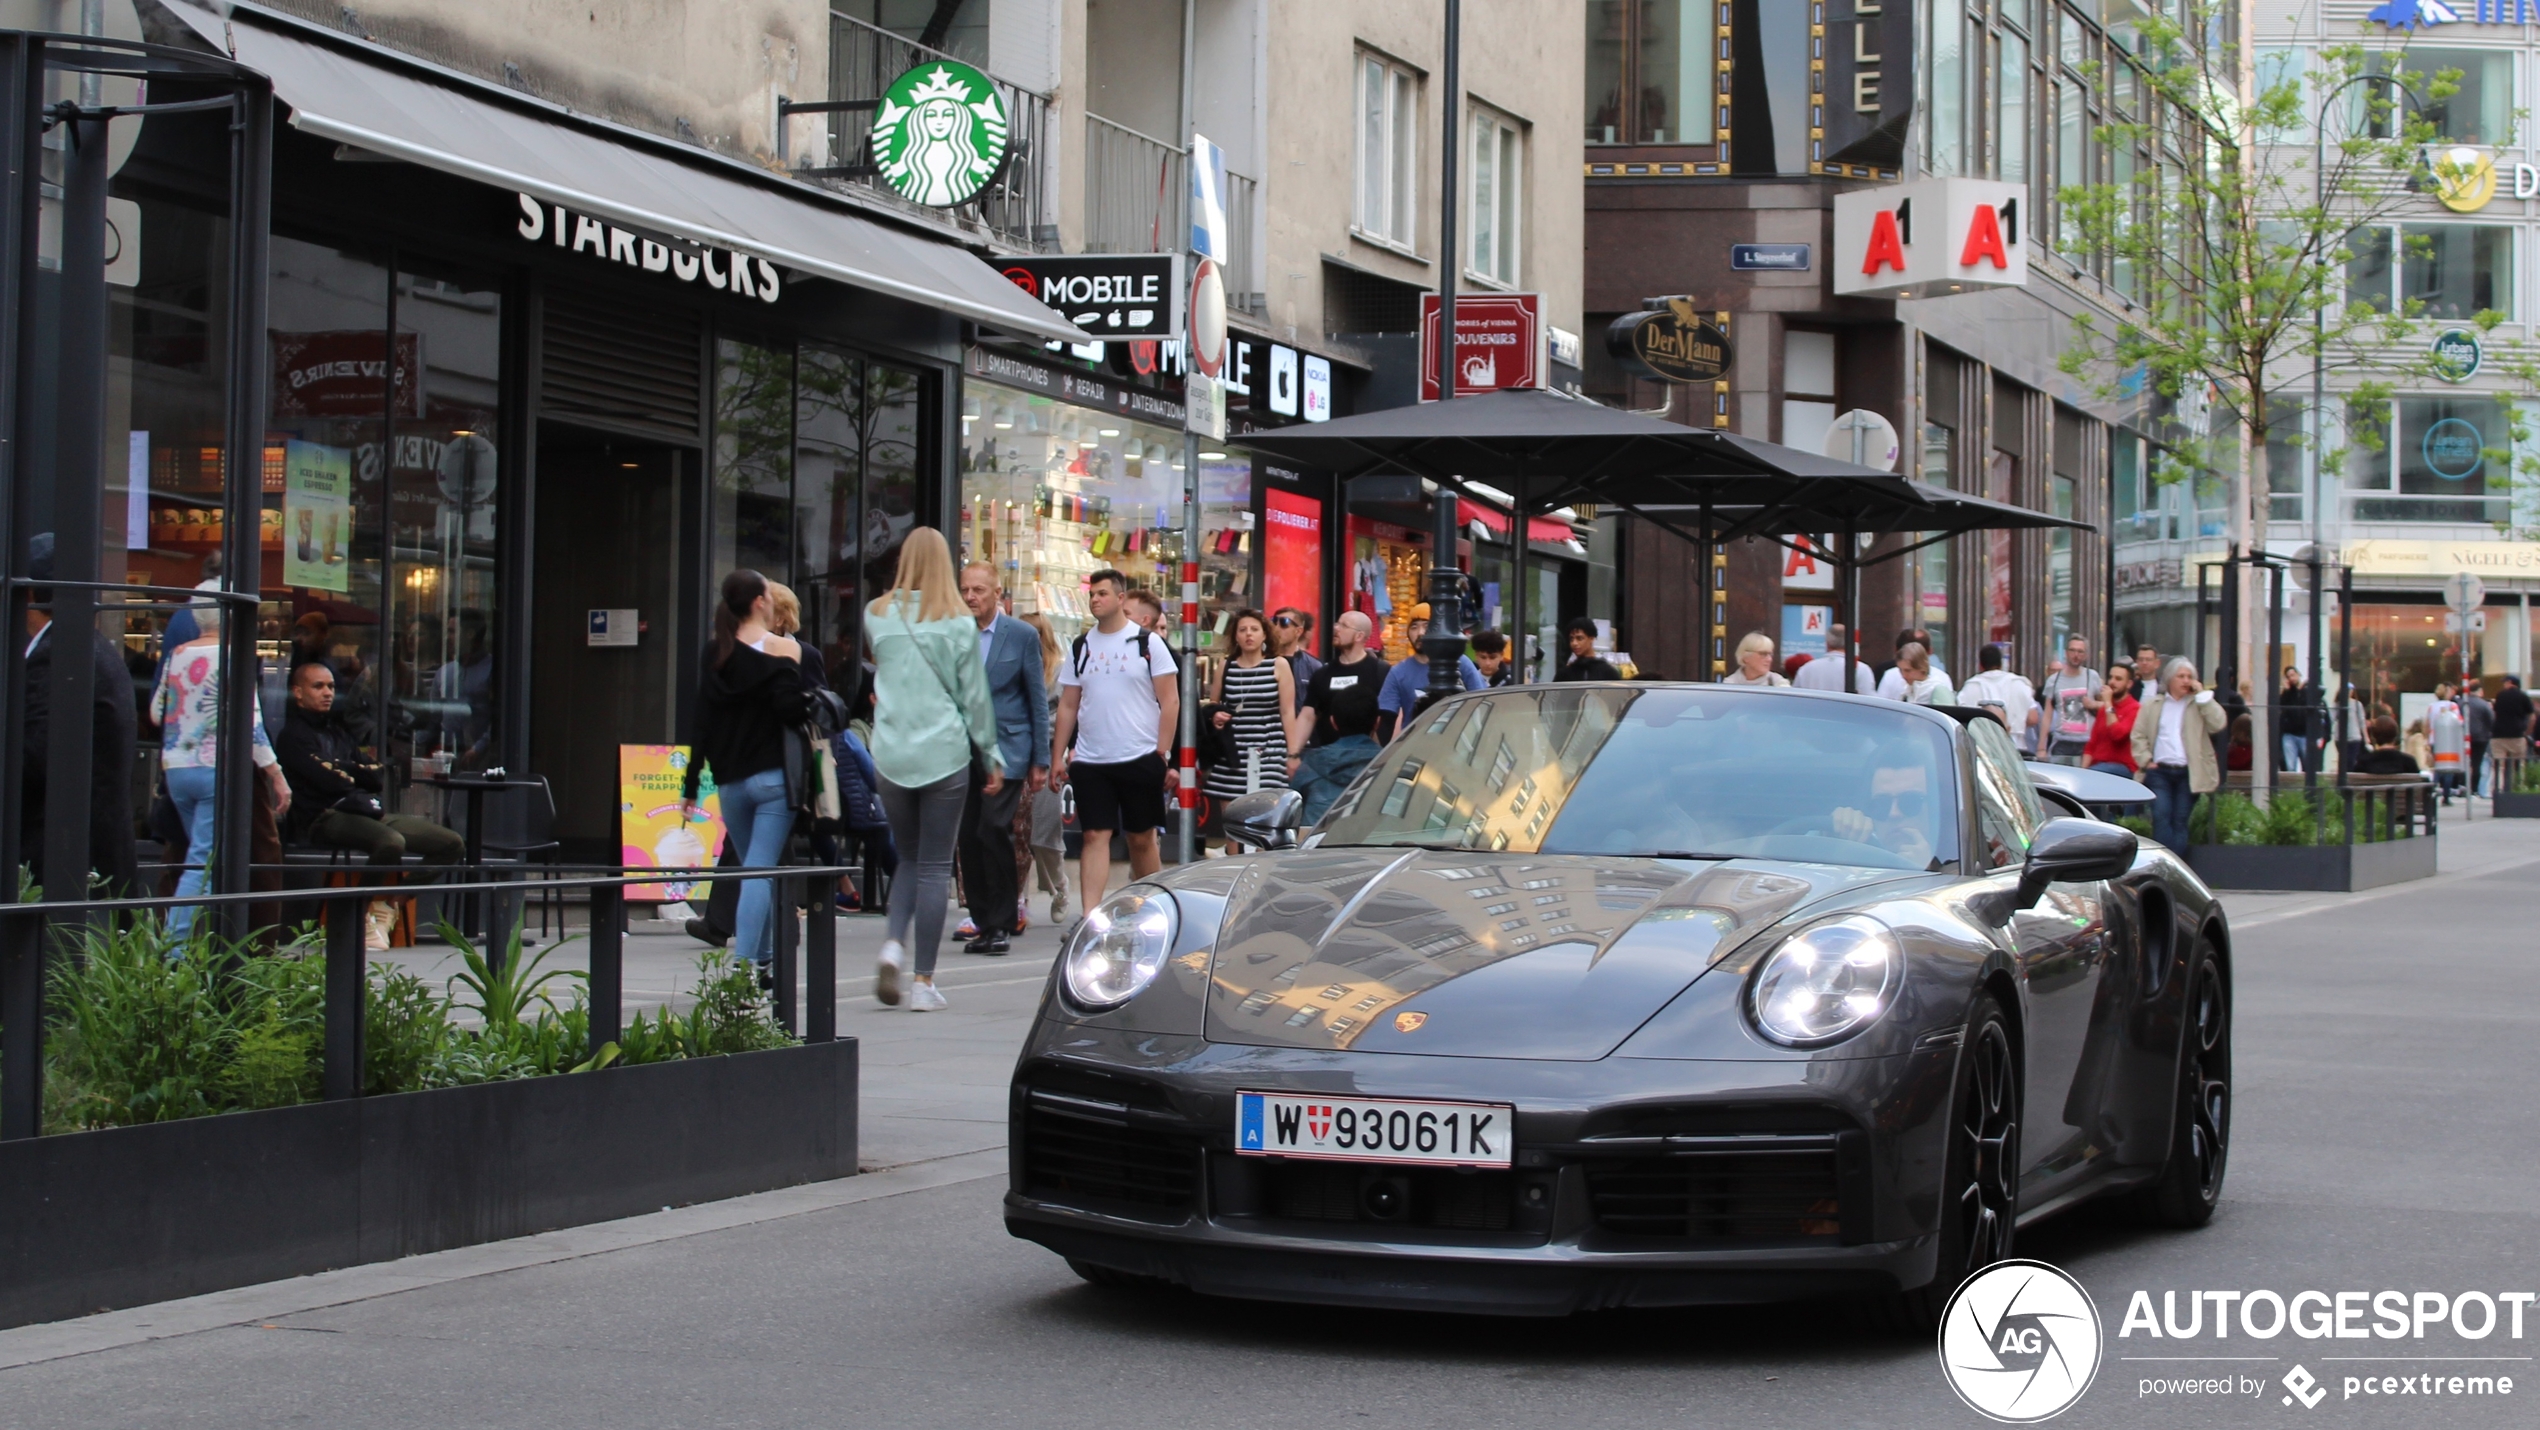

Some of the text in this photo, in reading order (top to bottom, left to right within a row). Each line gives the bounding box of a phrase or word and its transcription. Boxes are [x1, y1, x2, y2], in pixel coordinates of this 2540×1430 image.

[1862, 197, 1912, 274] A1
[1960, 197, 2017, 269] A1
[1043, 275, 1159, 303] MOBILE
[1455, 333, 1518, 345] OUVENIRS
[988, 354, 1049, 386] SMARTPHONES
[1306, 368, 1328, 383] NOKIA
[1076, 378, 1105, 400] REPAIR
[1132, 392, 1186, 418] INTERNATIONA
[304, 479, 333, 492] ESPRESSO
[1806, 610, 1823, 630] A1
[1247, 1103, 1493, 1155] A W 93061K
